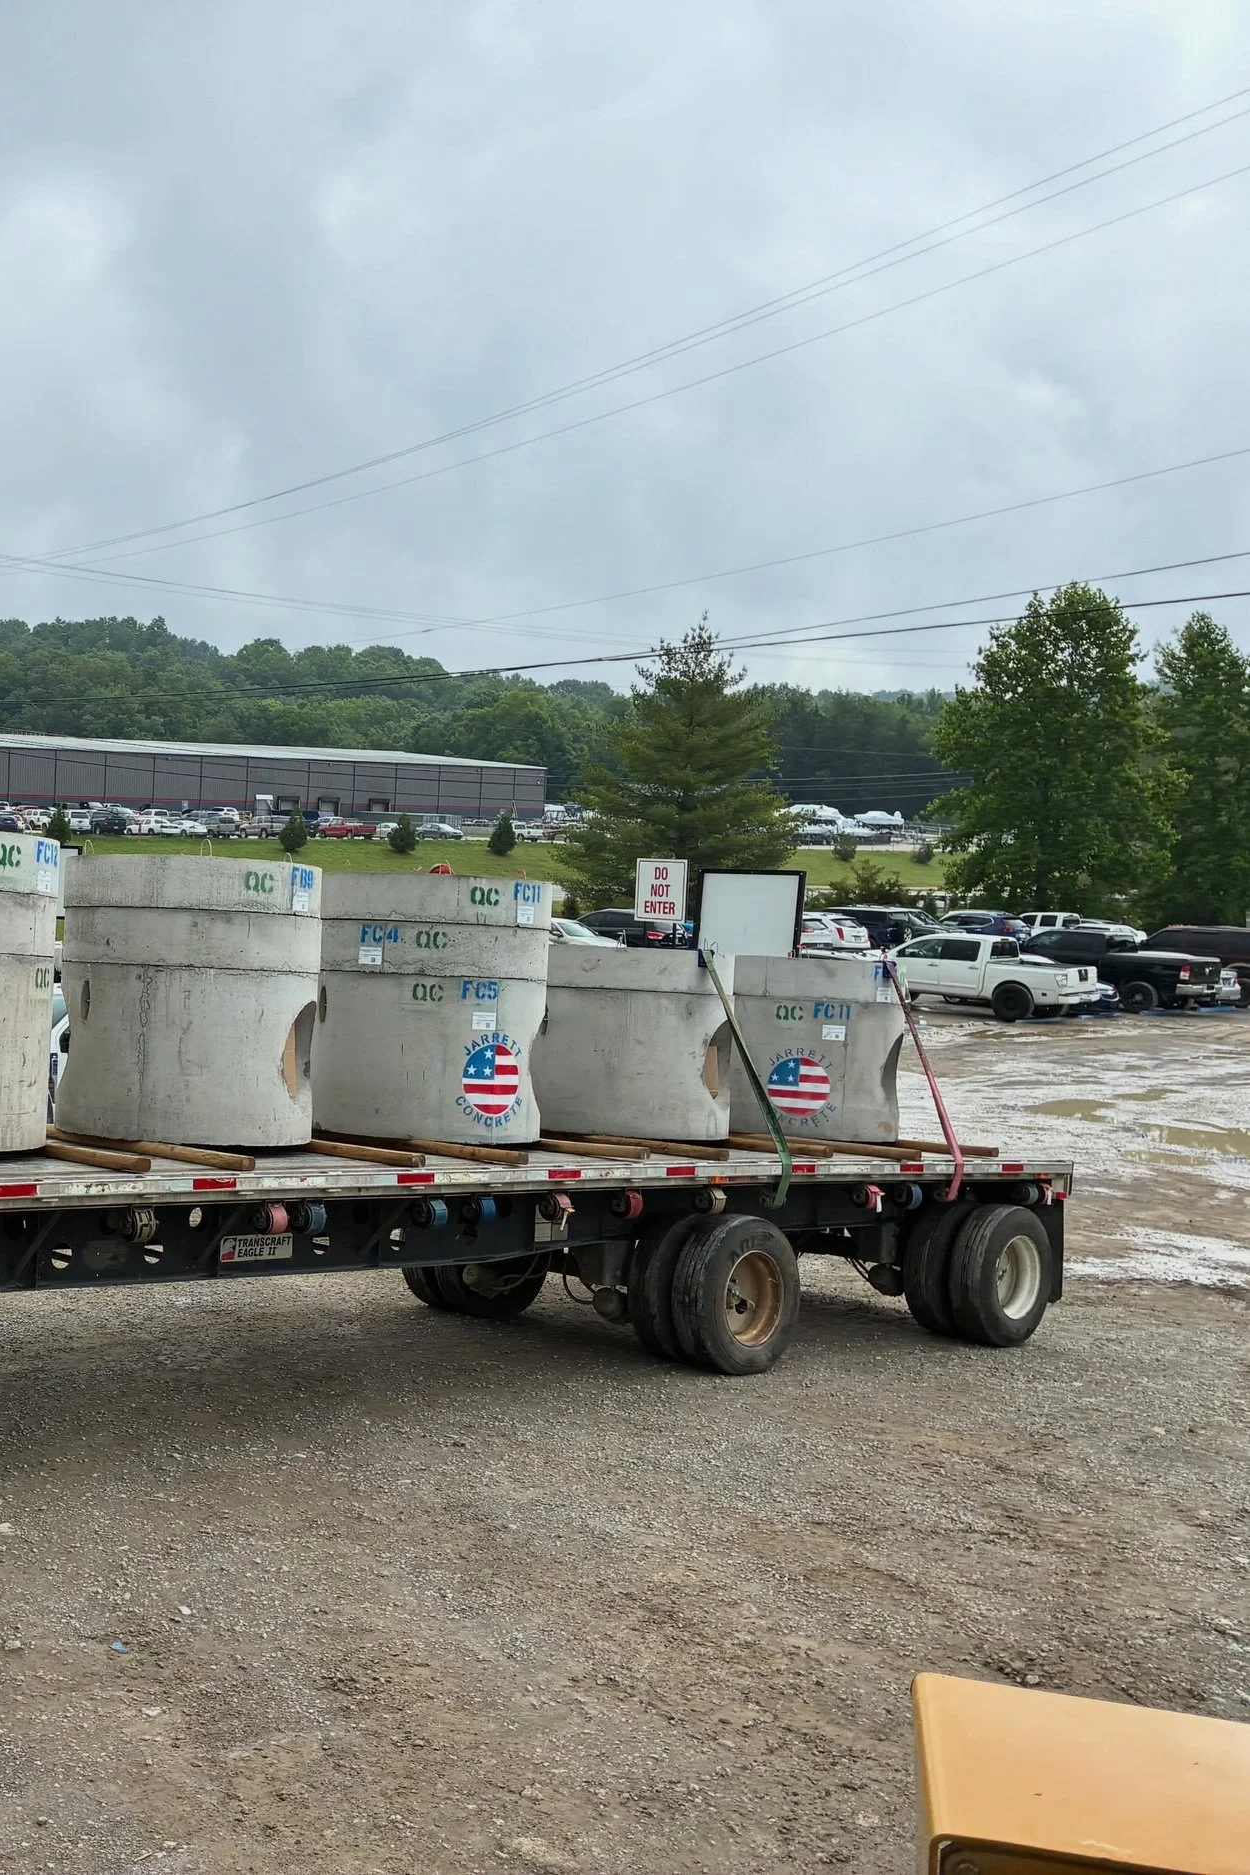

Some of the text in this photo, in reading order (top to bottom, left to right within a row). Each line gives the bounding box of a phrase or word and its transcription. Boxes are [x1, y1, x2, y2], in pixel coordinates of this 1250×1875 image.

[36, 841, 58, 868] FC12
[244, 866, 313, 894] QC FB9
[654, 867, 668, 880] DO
[470, 882, 541, 906] QC FC11
[650, 884, 671, 897] NOT
[644, 901, 675, 915] ENTER
[360, 923, 448, 949] FC4 QC
[35, 967, 50, 989] QC
[412, 980, 498, 1001] QC FC5
[776, 1001, 851, 1020] QC FC11
[463, 1032, 522, 1057] JARRETT
[769, 1047, 833, 1069] JARRETT
[456, 1096, 523, 1128] CONCRETE
[776, 1102, 837, 1128] NCRETE
[237, 1236, 292, 1248] TRANSCRAFT
[237, 1247, 277, 1257] EAGLE II
